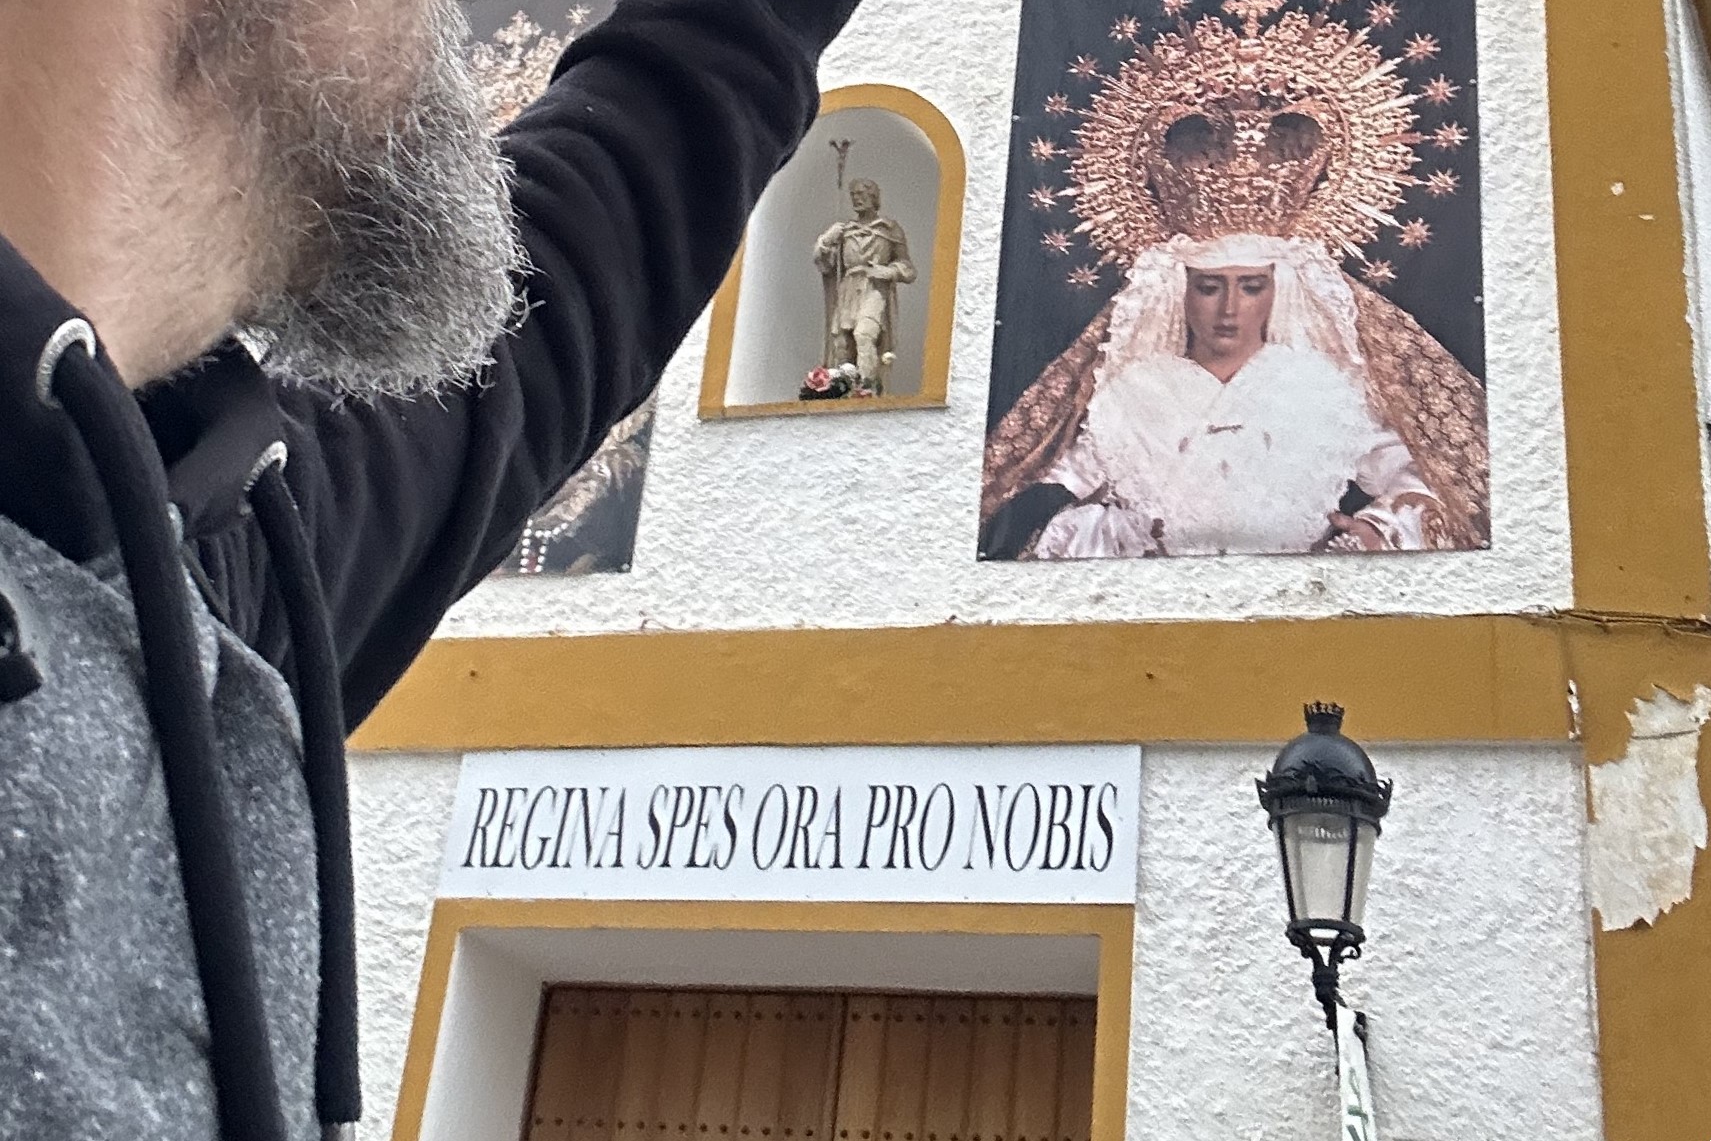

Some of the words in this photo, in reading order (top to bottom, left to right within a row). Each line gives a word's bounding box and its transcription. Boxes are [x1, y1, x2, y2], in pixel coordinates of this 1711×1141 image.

[462, 786, 627, 870] REGINA
[636, 784, 745, 871] SPES
[751, 783, 843, 871] ORA
[856, 783, 955, 871] PRO
[962, 782, 1119, 872] NOBIS
